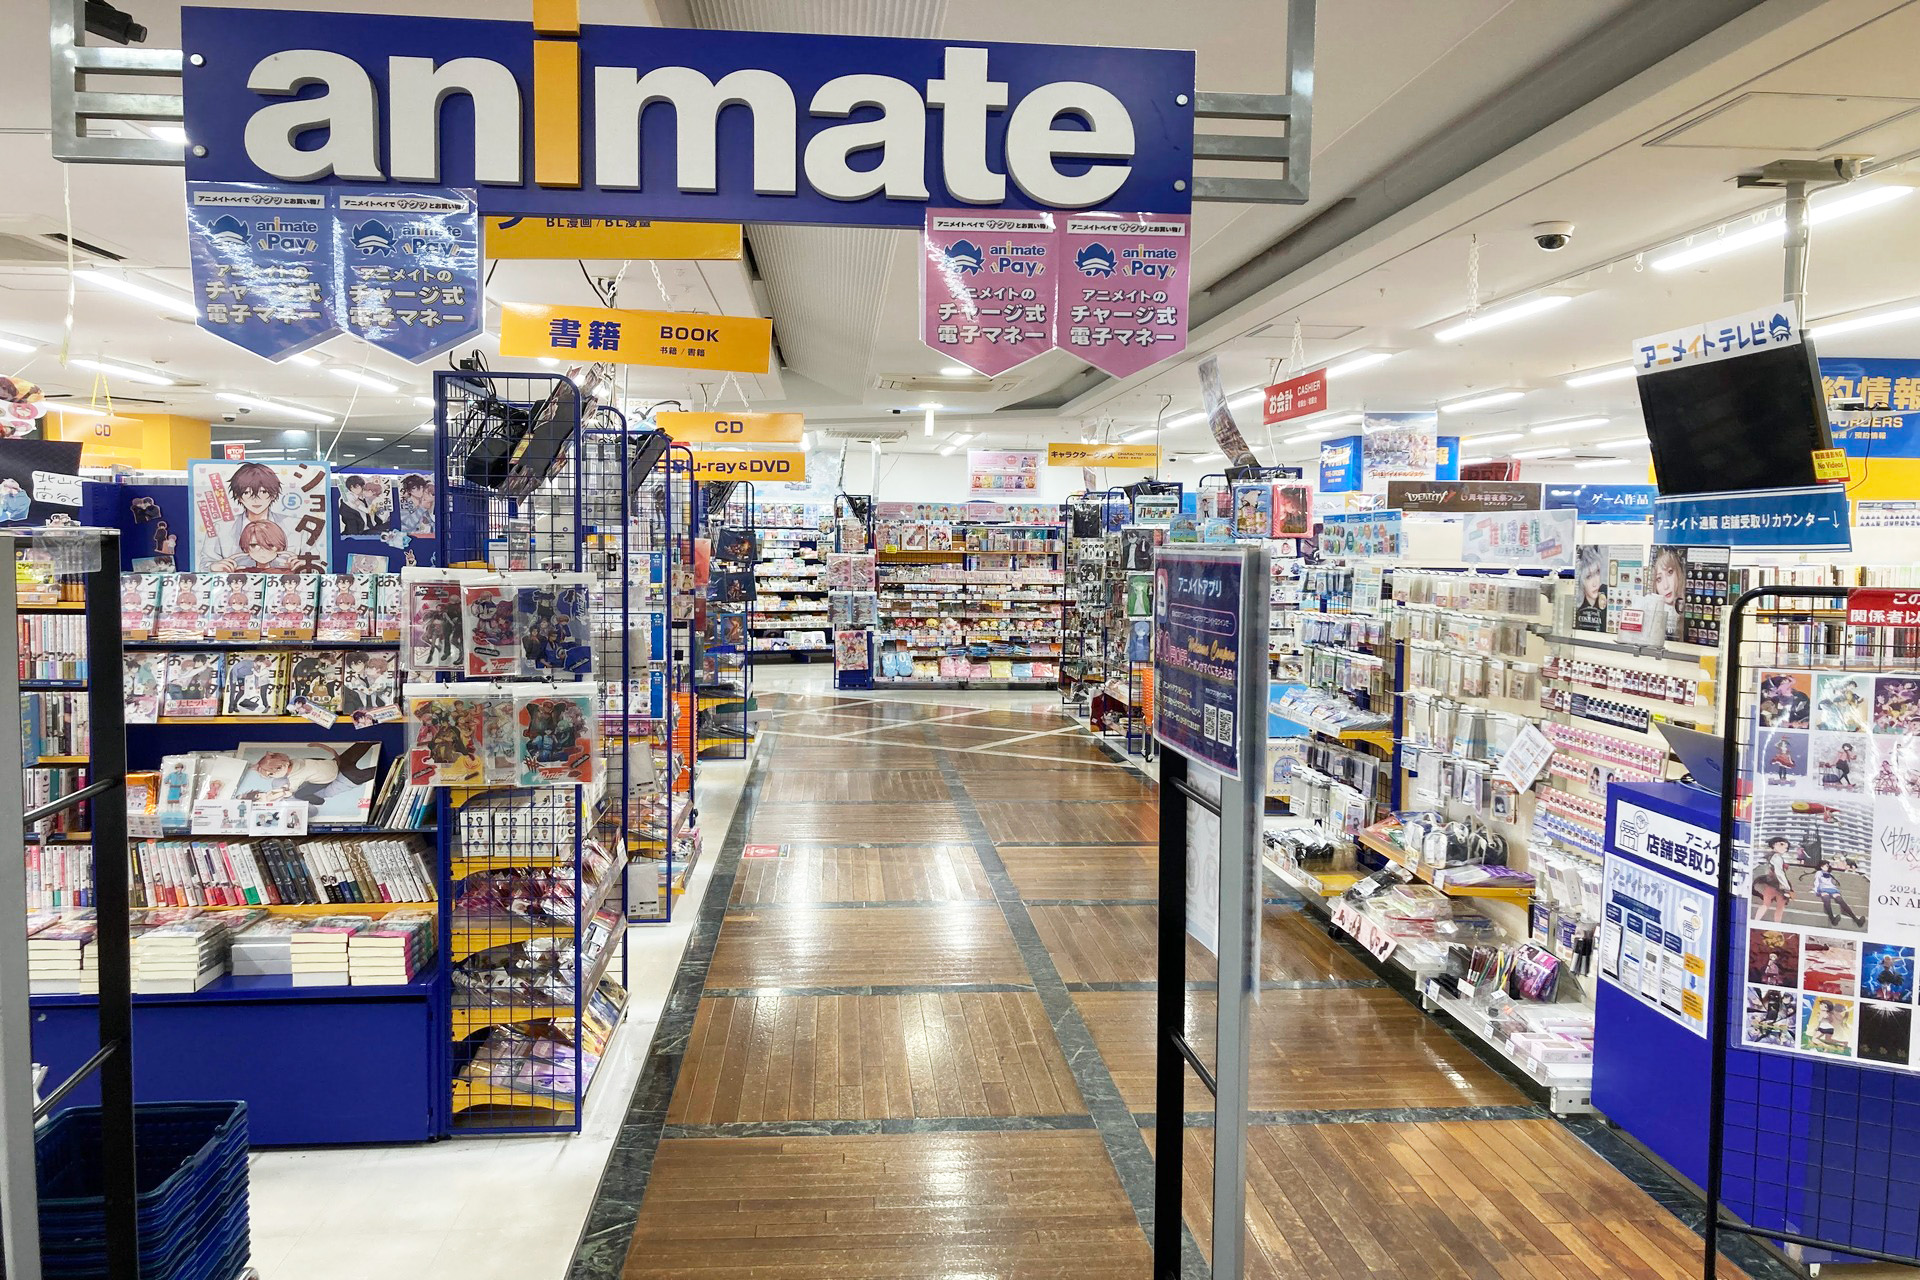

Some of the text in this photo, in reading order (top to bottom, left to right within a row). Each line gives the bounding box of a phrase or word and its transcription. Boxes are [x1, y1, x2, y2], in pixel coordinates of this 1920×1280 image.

[243, 0, 1136, 208] animate
[256, 216, 318, 233] animate
[267, 233, 310, 255] Pay
[989, 240, 1046, 257] animate
[1122, 243, 1177, 260] animate
[999, 258, 1038, 277] Pay
[1131, 261, 1169, 281] Pay
[349, 285, 466, 307] チャージ式
[1082, 289, 1168, 303] アニメイトの
[349, 308, 465, 328] 電子マネー
[938, 303, 1047, 324] チャージ式
[1070, 305, 1177, 326] チャージ式
[549, 318, 622, 351] 書籍
[660, 326, 720, 343] BOOK
[937, 325, 1046, 345] 電子マネー
[1070, 327, 1176, 348] 電子マネー
[1640, 319, 1767, 369] アニメイトテレビ
[1297, 380, 1321, 397] CASHIER
[1269, 388, 1294, 415] お会計
[94, 423, 111, 437] CD
[714, 420, 744, 434] CD
[287, 496, 297, 507] 5
[382, 476, 393, 511] ショタおに
[1591, 493, 1649, 506] ゲーム作品
[1657, 510, 1831, 532] アニメイト通販 店舗受取りカウンター
[142, 574, 159, 616] ショタ
[198, 574, 214, 616] ショタ
[249, 574, 264, 616] ショタ
[303, 574, 317, 616] ショタ
[1877, 894, 1901, 907] ON
